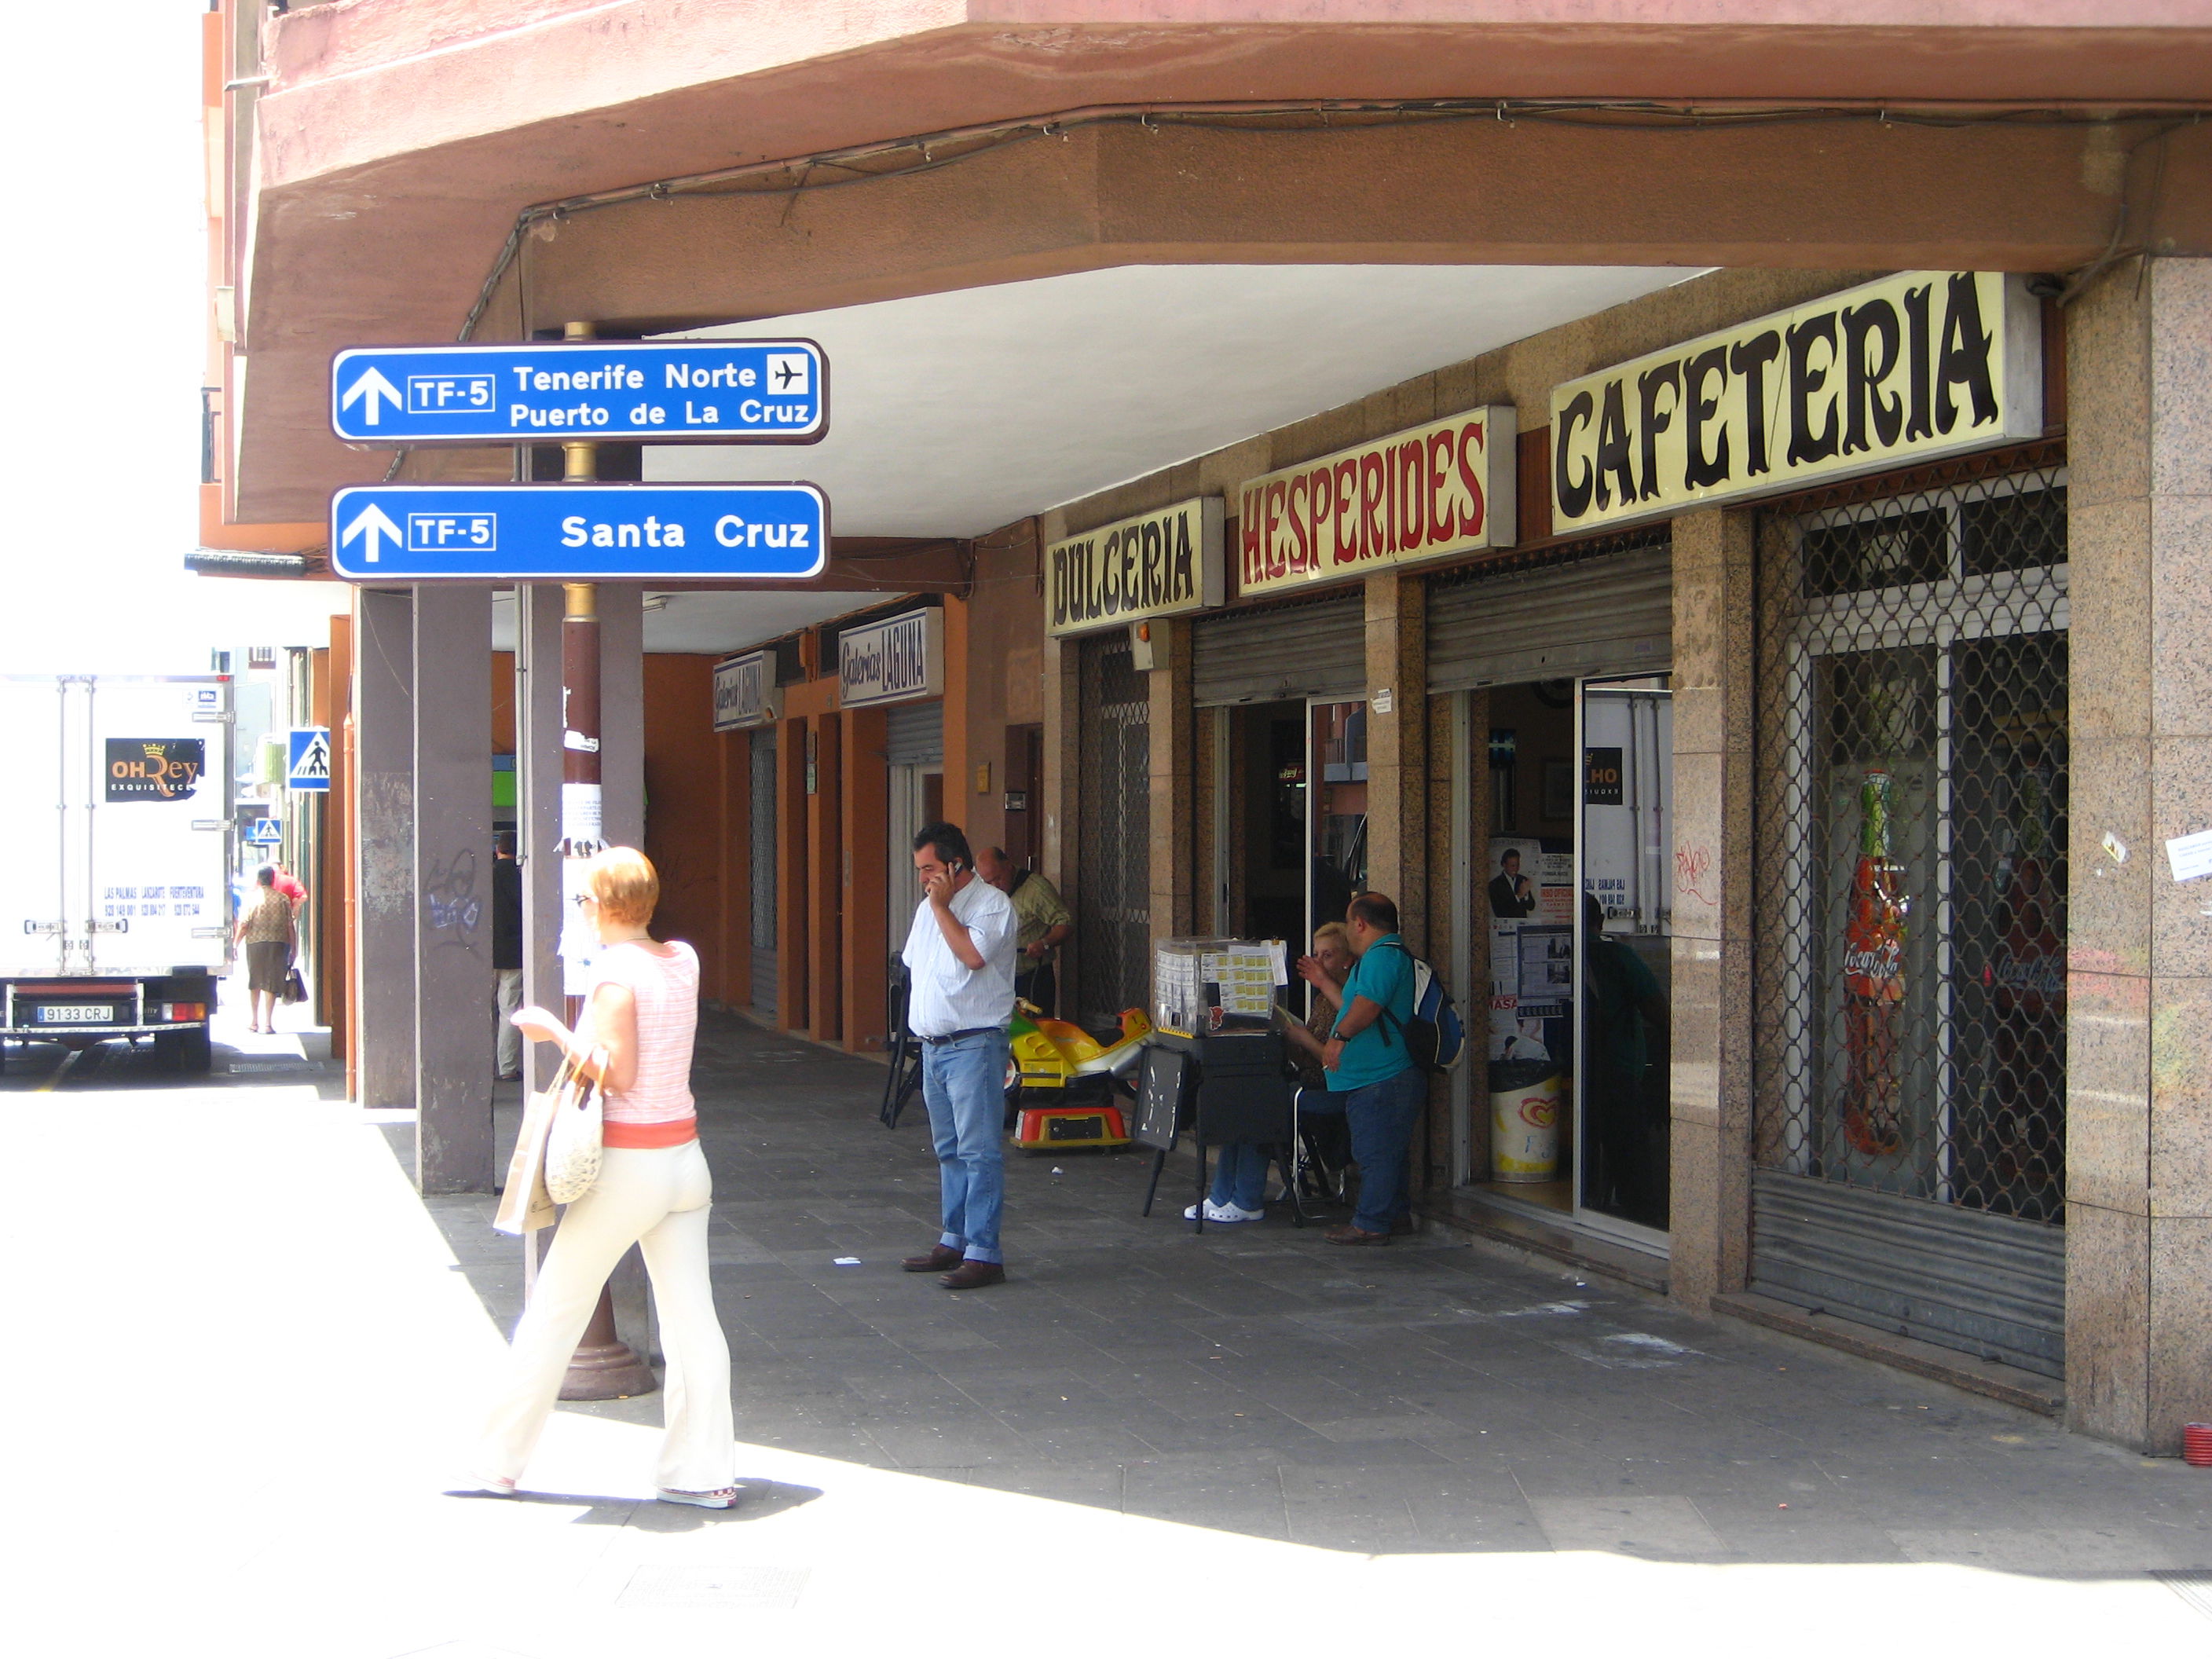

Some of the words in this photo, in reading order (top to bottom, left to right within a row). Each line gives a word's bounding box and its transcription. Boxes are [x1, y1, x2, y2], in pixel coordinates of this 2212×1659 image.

[514, 364, 644, 391] Tenerife
[665, 362, 756, 389] Norte
[414, 380, 489, 408] TF-5
[1556, 270, 1998, 518] CAFETERIA
[511, 402, 610, 427] Puerto
[629, 403, 666, 425] de
[686, 401, 720, 424] La
[740, 398, 810, 423] Cruz
[1243, 421, 1485, 584] HESPERIDES
[415, 518, 490, 544] TF-5
[561, 515, 686, 548] Santa
[715, 515, 810, 548] Cruz
[1053, 511, 1194, 627] DULCERIA
[882, 620, 924, 692] LAGUNA
[47, 1008, 80, 1020] 9133
[85, 1008, 111, 1020] CRJ
